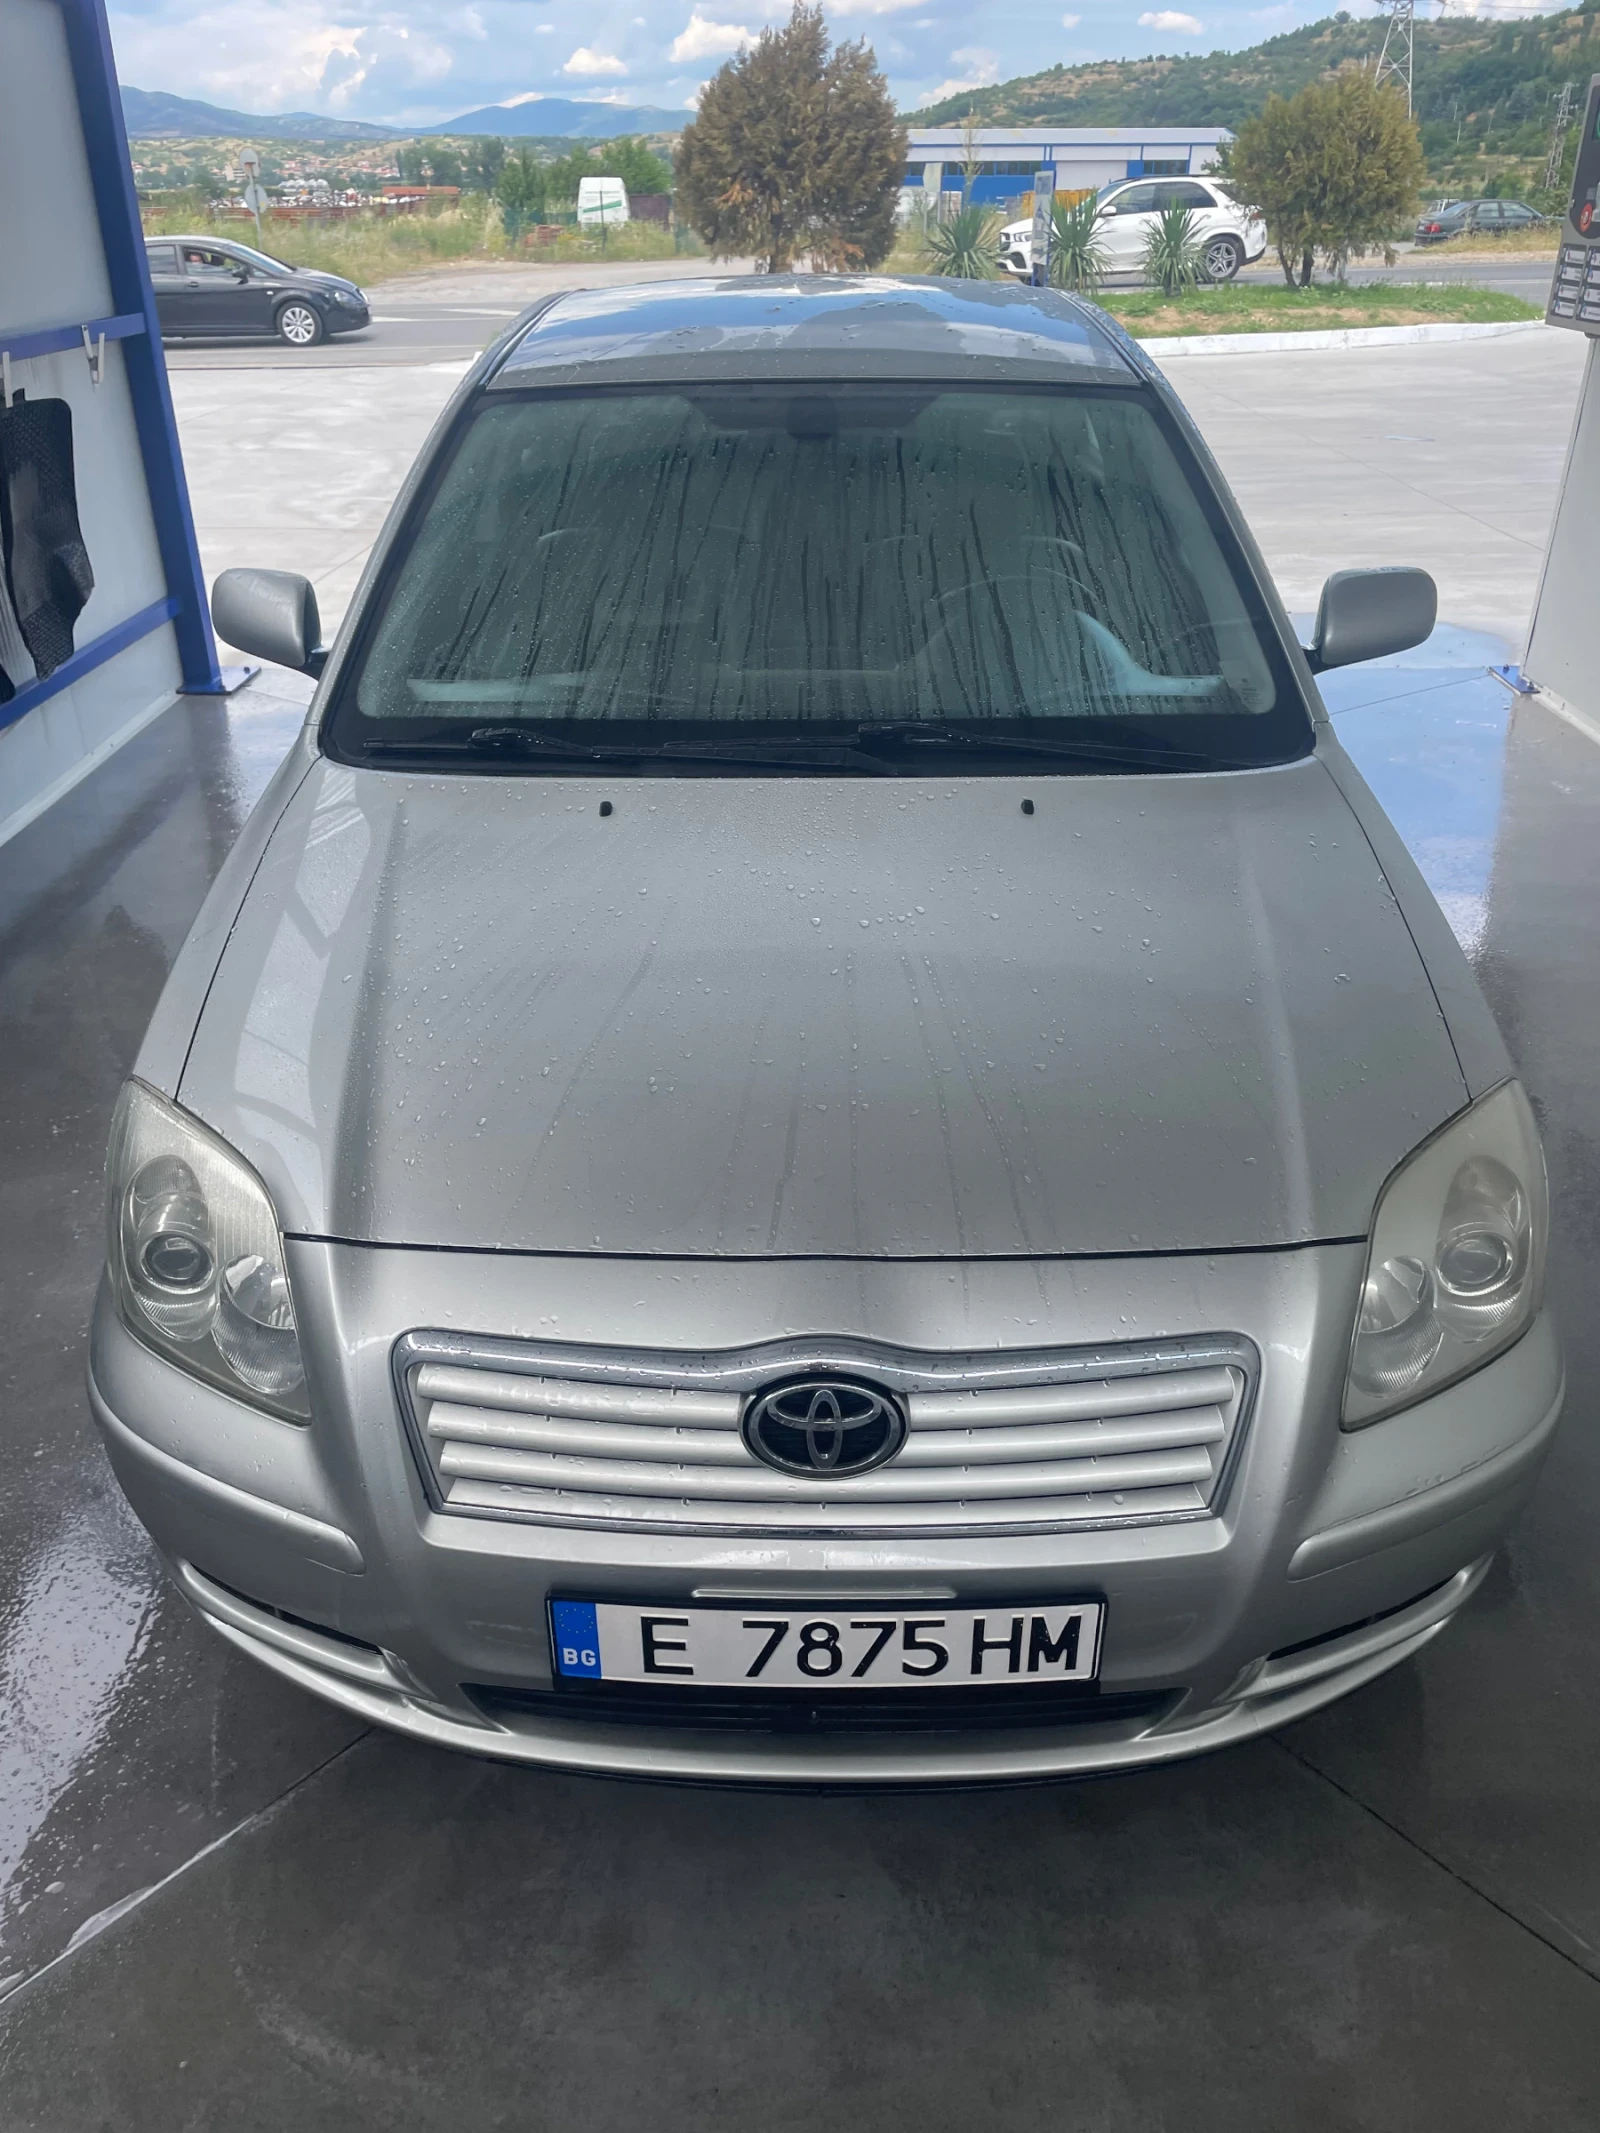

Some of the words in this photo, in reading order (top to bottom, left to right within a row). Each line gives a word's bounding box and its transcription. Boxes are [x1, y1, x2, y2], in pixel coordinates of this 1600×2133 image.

[562, 1647, 596, 1667] BG
[640, 1616, 694, 1676] E
[742, 1619, 949, 1678] 7875
[970, 1615, 1082, 1676] HM
